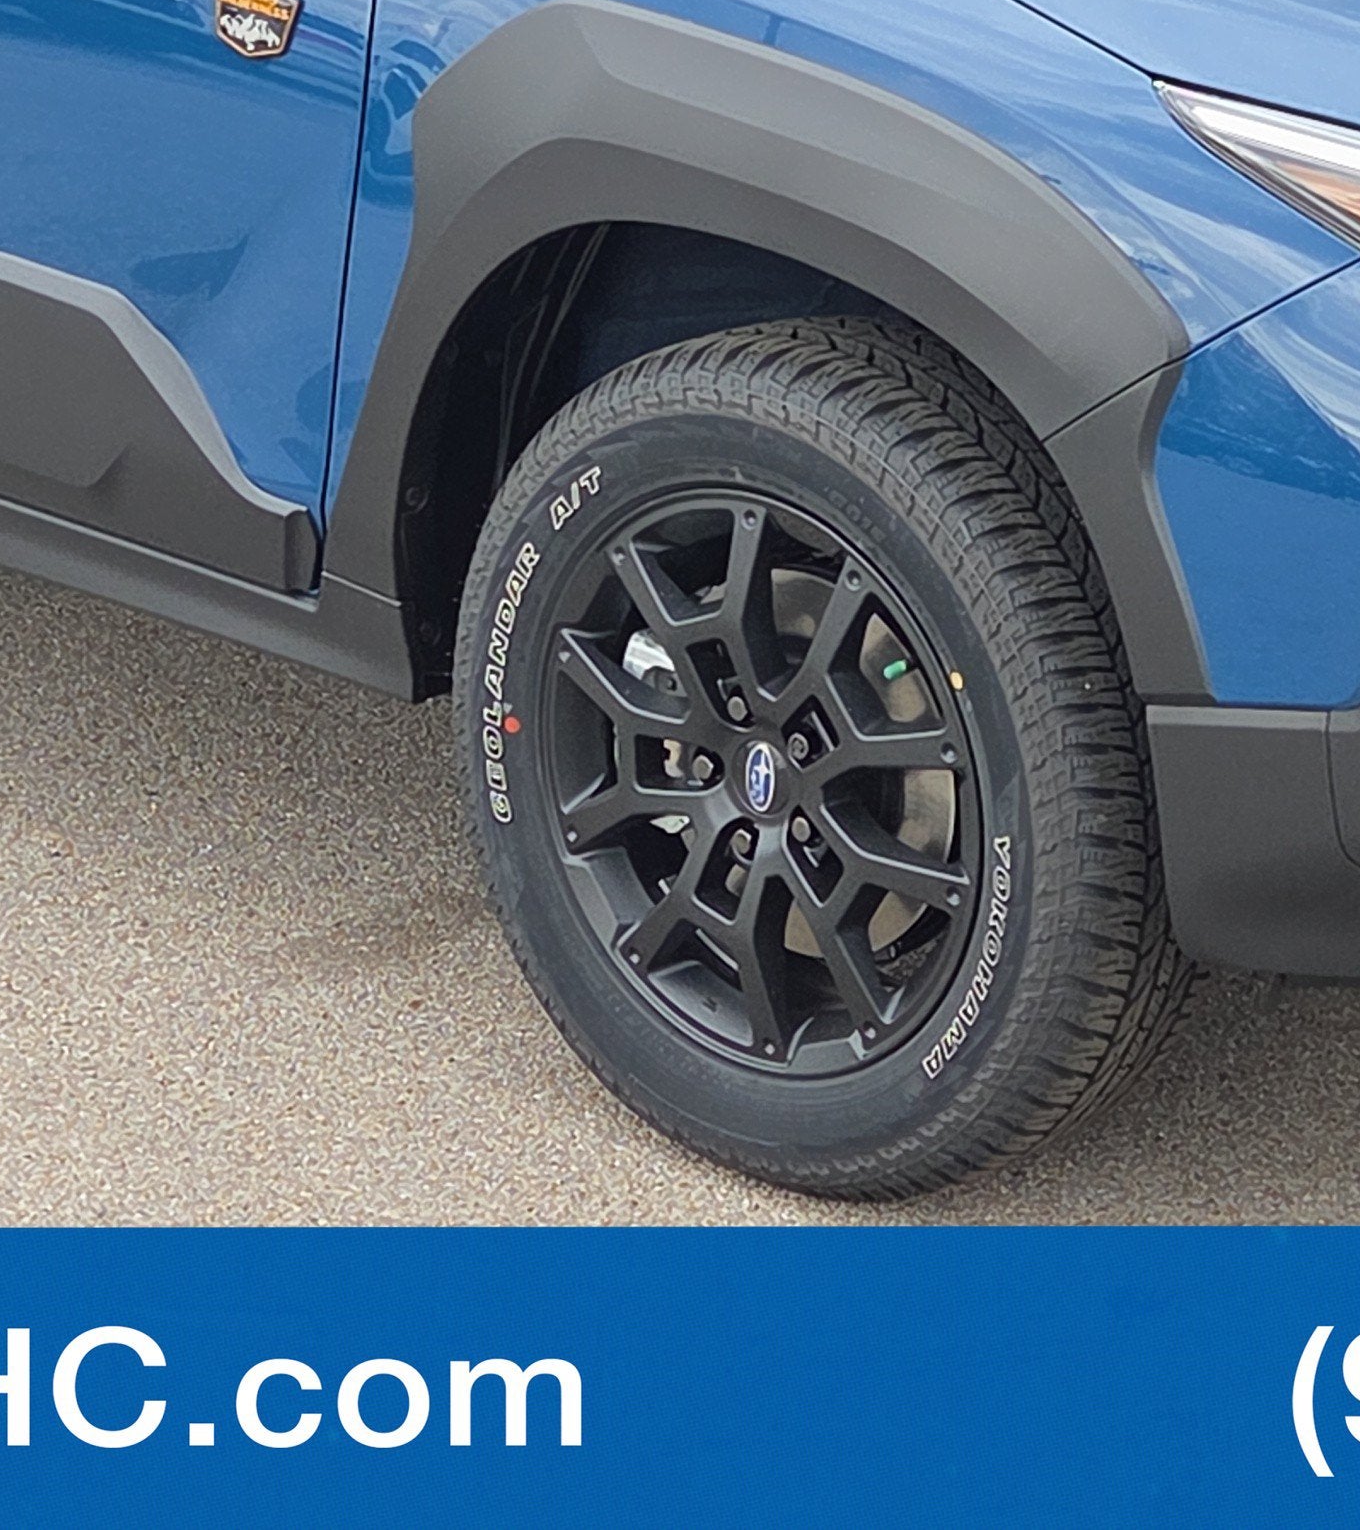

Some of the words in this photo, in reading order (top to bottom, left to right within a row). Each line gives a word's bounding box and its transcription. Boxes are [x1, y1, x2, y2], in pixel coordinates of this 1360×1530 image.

[483, 541, 541, 824] GEOLANDAR
[549, 466, 601, 530] A/T
[921, 835, 1011, 1079] YOKOHAMA
